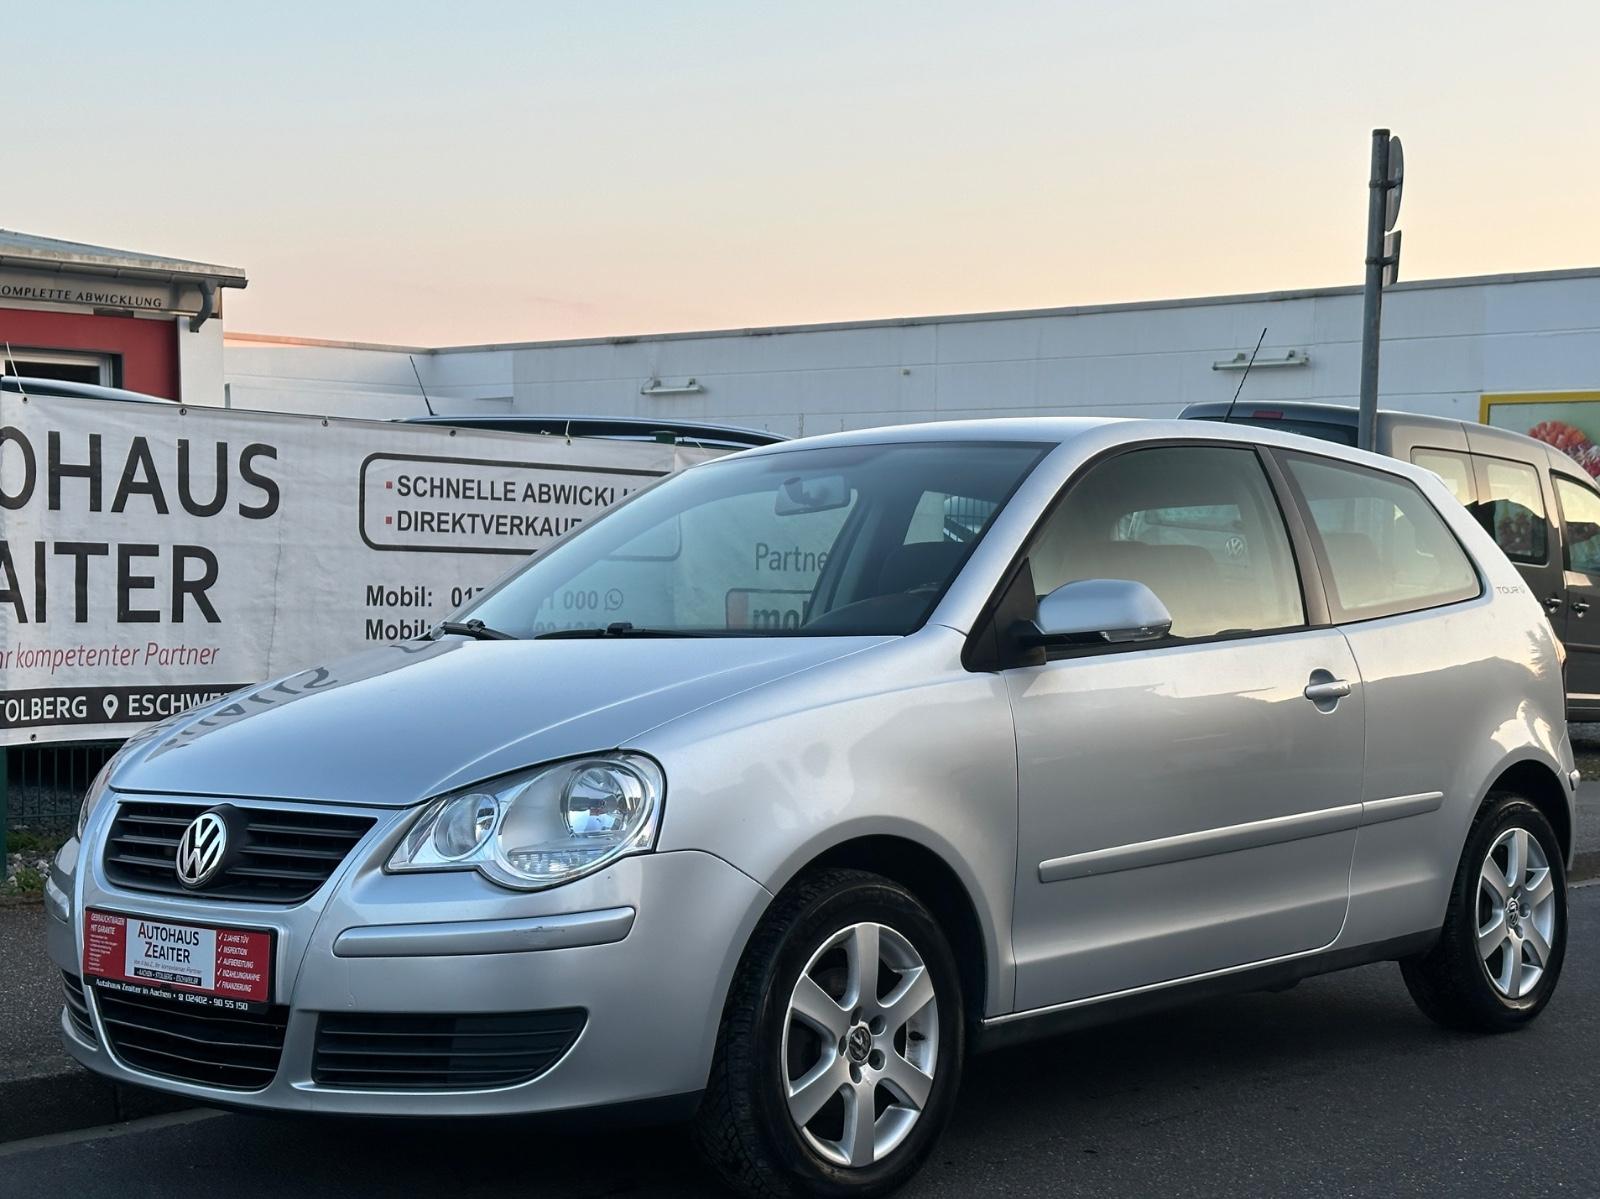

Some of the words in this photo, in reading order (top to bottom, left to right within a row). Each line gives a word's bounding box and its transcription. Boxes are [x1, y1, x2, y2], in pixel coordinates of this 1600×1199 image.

[76, 292, 162, 307] ABWICKLUNG
[397, 475, 516, 502] SCHNELLE
[366, 585, 432, 608] Mobil:
[16, 642, 141, 675] kompetenter
[144, 642, 220, 666] Partner
[128, 693, 228, 716] ESCHW
